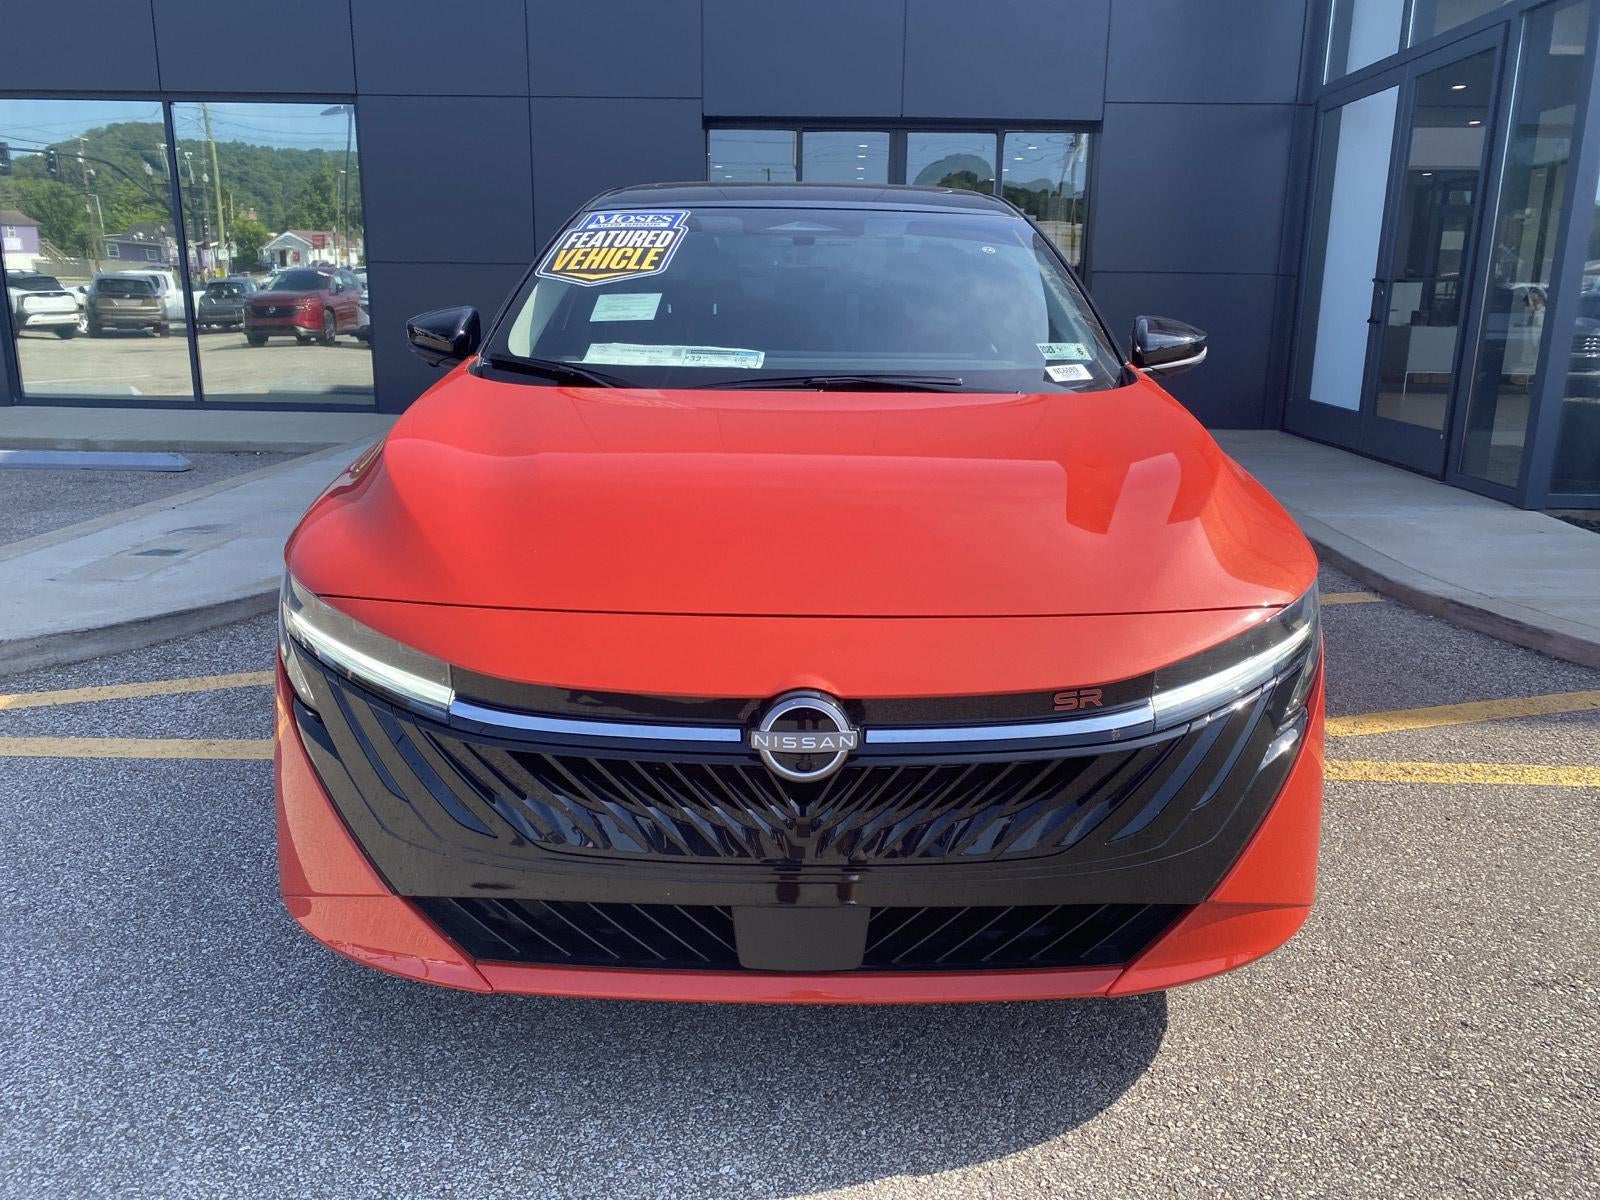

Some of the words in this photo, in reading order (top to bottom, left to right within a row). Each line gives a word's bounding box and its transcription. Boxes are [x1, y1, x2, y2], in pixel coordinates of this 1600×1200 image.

[593, 214, 675, 223] MOSES
[563, 230, 675, 249] FEATURED
[552, 247, 664, 271] VEHICLE
[1054, 688, 1103, 711] SR
[754, 734, 854, 749] NISSAN
